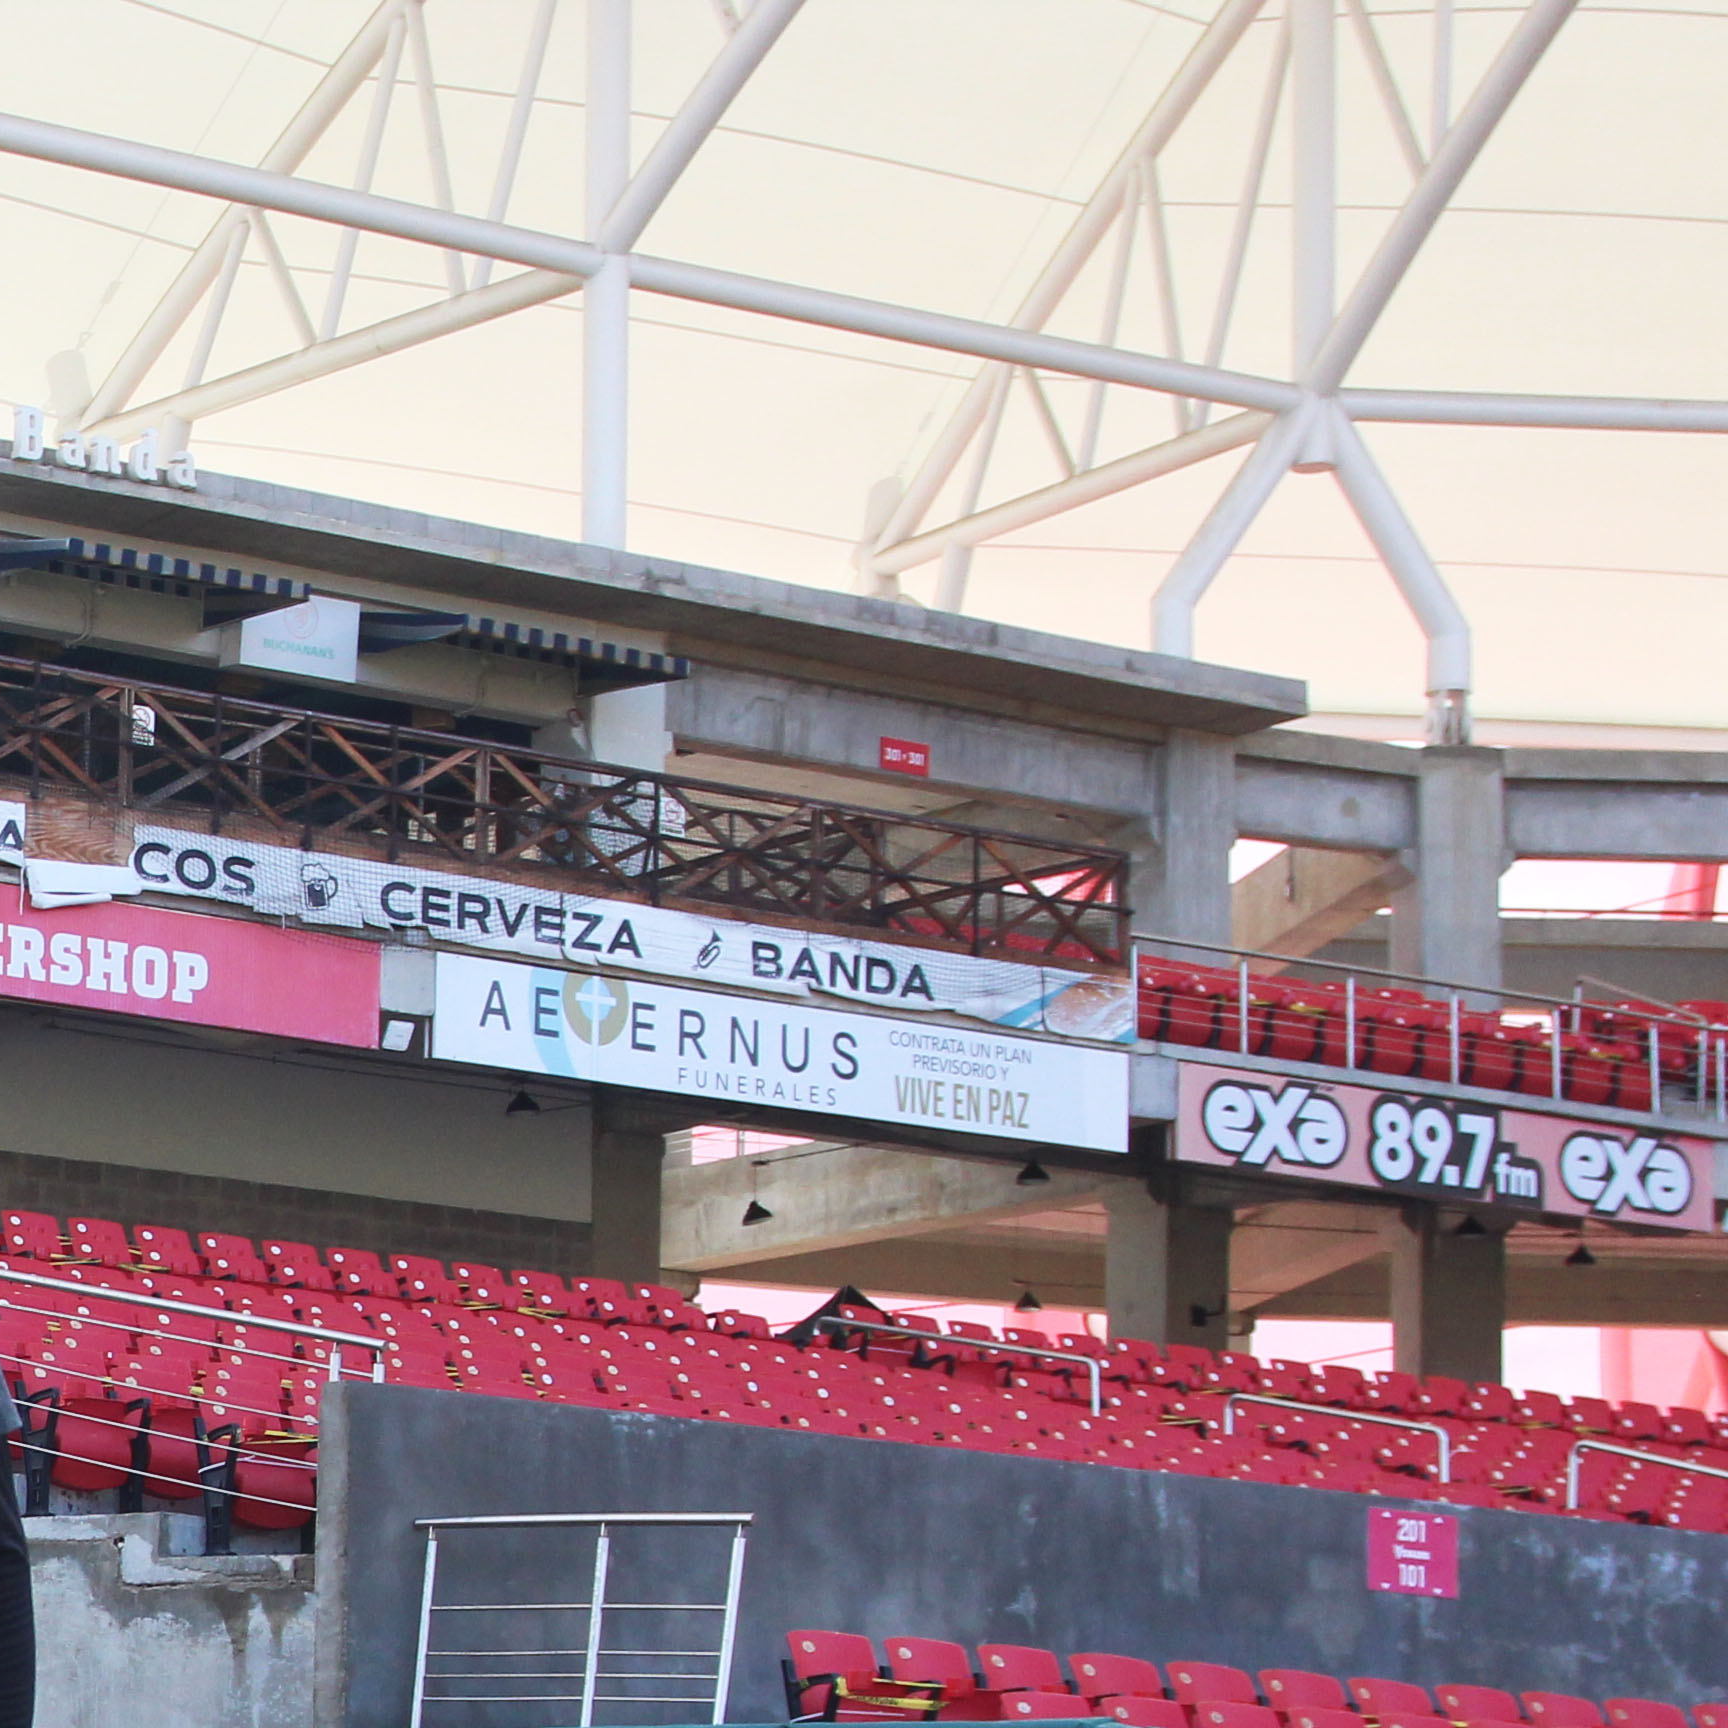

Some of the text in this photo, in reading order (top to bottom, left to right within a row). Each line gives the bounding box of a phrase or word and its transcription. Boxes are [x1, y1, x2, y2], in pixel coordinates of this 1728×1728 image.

[10, 404, 198, 491] Banda
[380, 881, 643, 959] CERVEZA
[751, 940, 934, 1001] BANDA
[889, 1030, 1032, 1066] CONTRATA UN PLAN
[912, 1054, 1009, 1081] PREVISORIO Y
[677, 1067, 837, 1108] FUNERALES
[894, 1075, 1031, 1129] VIVE EN PAZ
[1202, 1083, 1693, 1213] exa 89.7 fm exa
[1396, 1518, 1427, 1543] 201
[1398, 1563, 1426, 1588] 101
